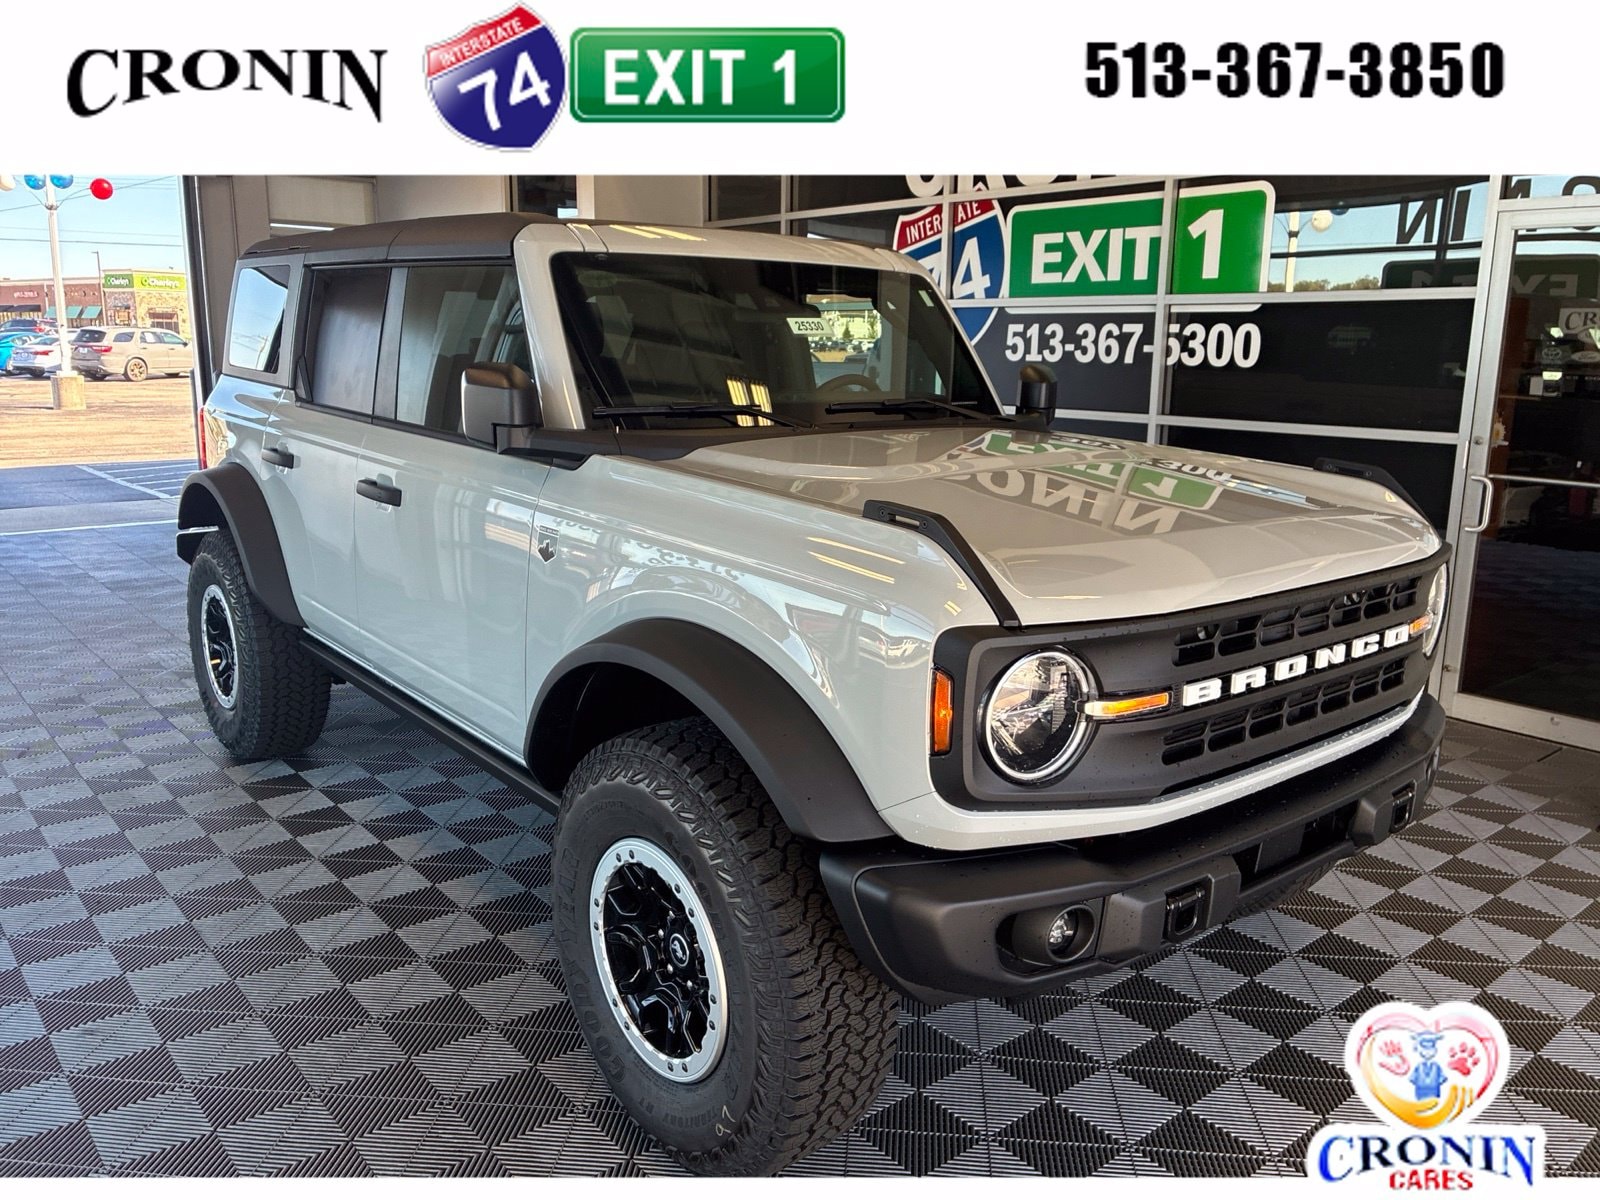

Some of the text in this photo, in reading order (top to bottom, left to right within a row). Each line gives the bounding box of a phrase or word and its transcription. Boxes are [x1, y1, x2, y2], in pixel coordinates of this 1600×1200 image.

[905, 200, 981, 245] INTERATE
[1031, 208, 1224, 285] EXIT 1
[794, 320, 824, 331] 25330
[1005, 322, 1261, 369] 513-367-5300
[1182, 624, 1409, 707] BRONCO
